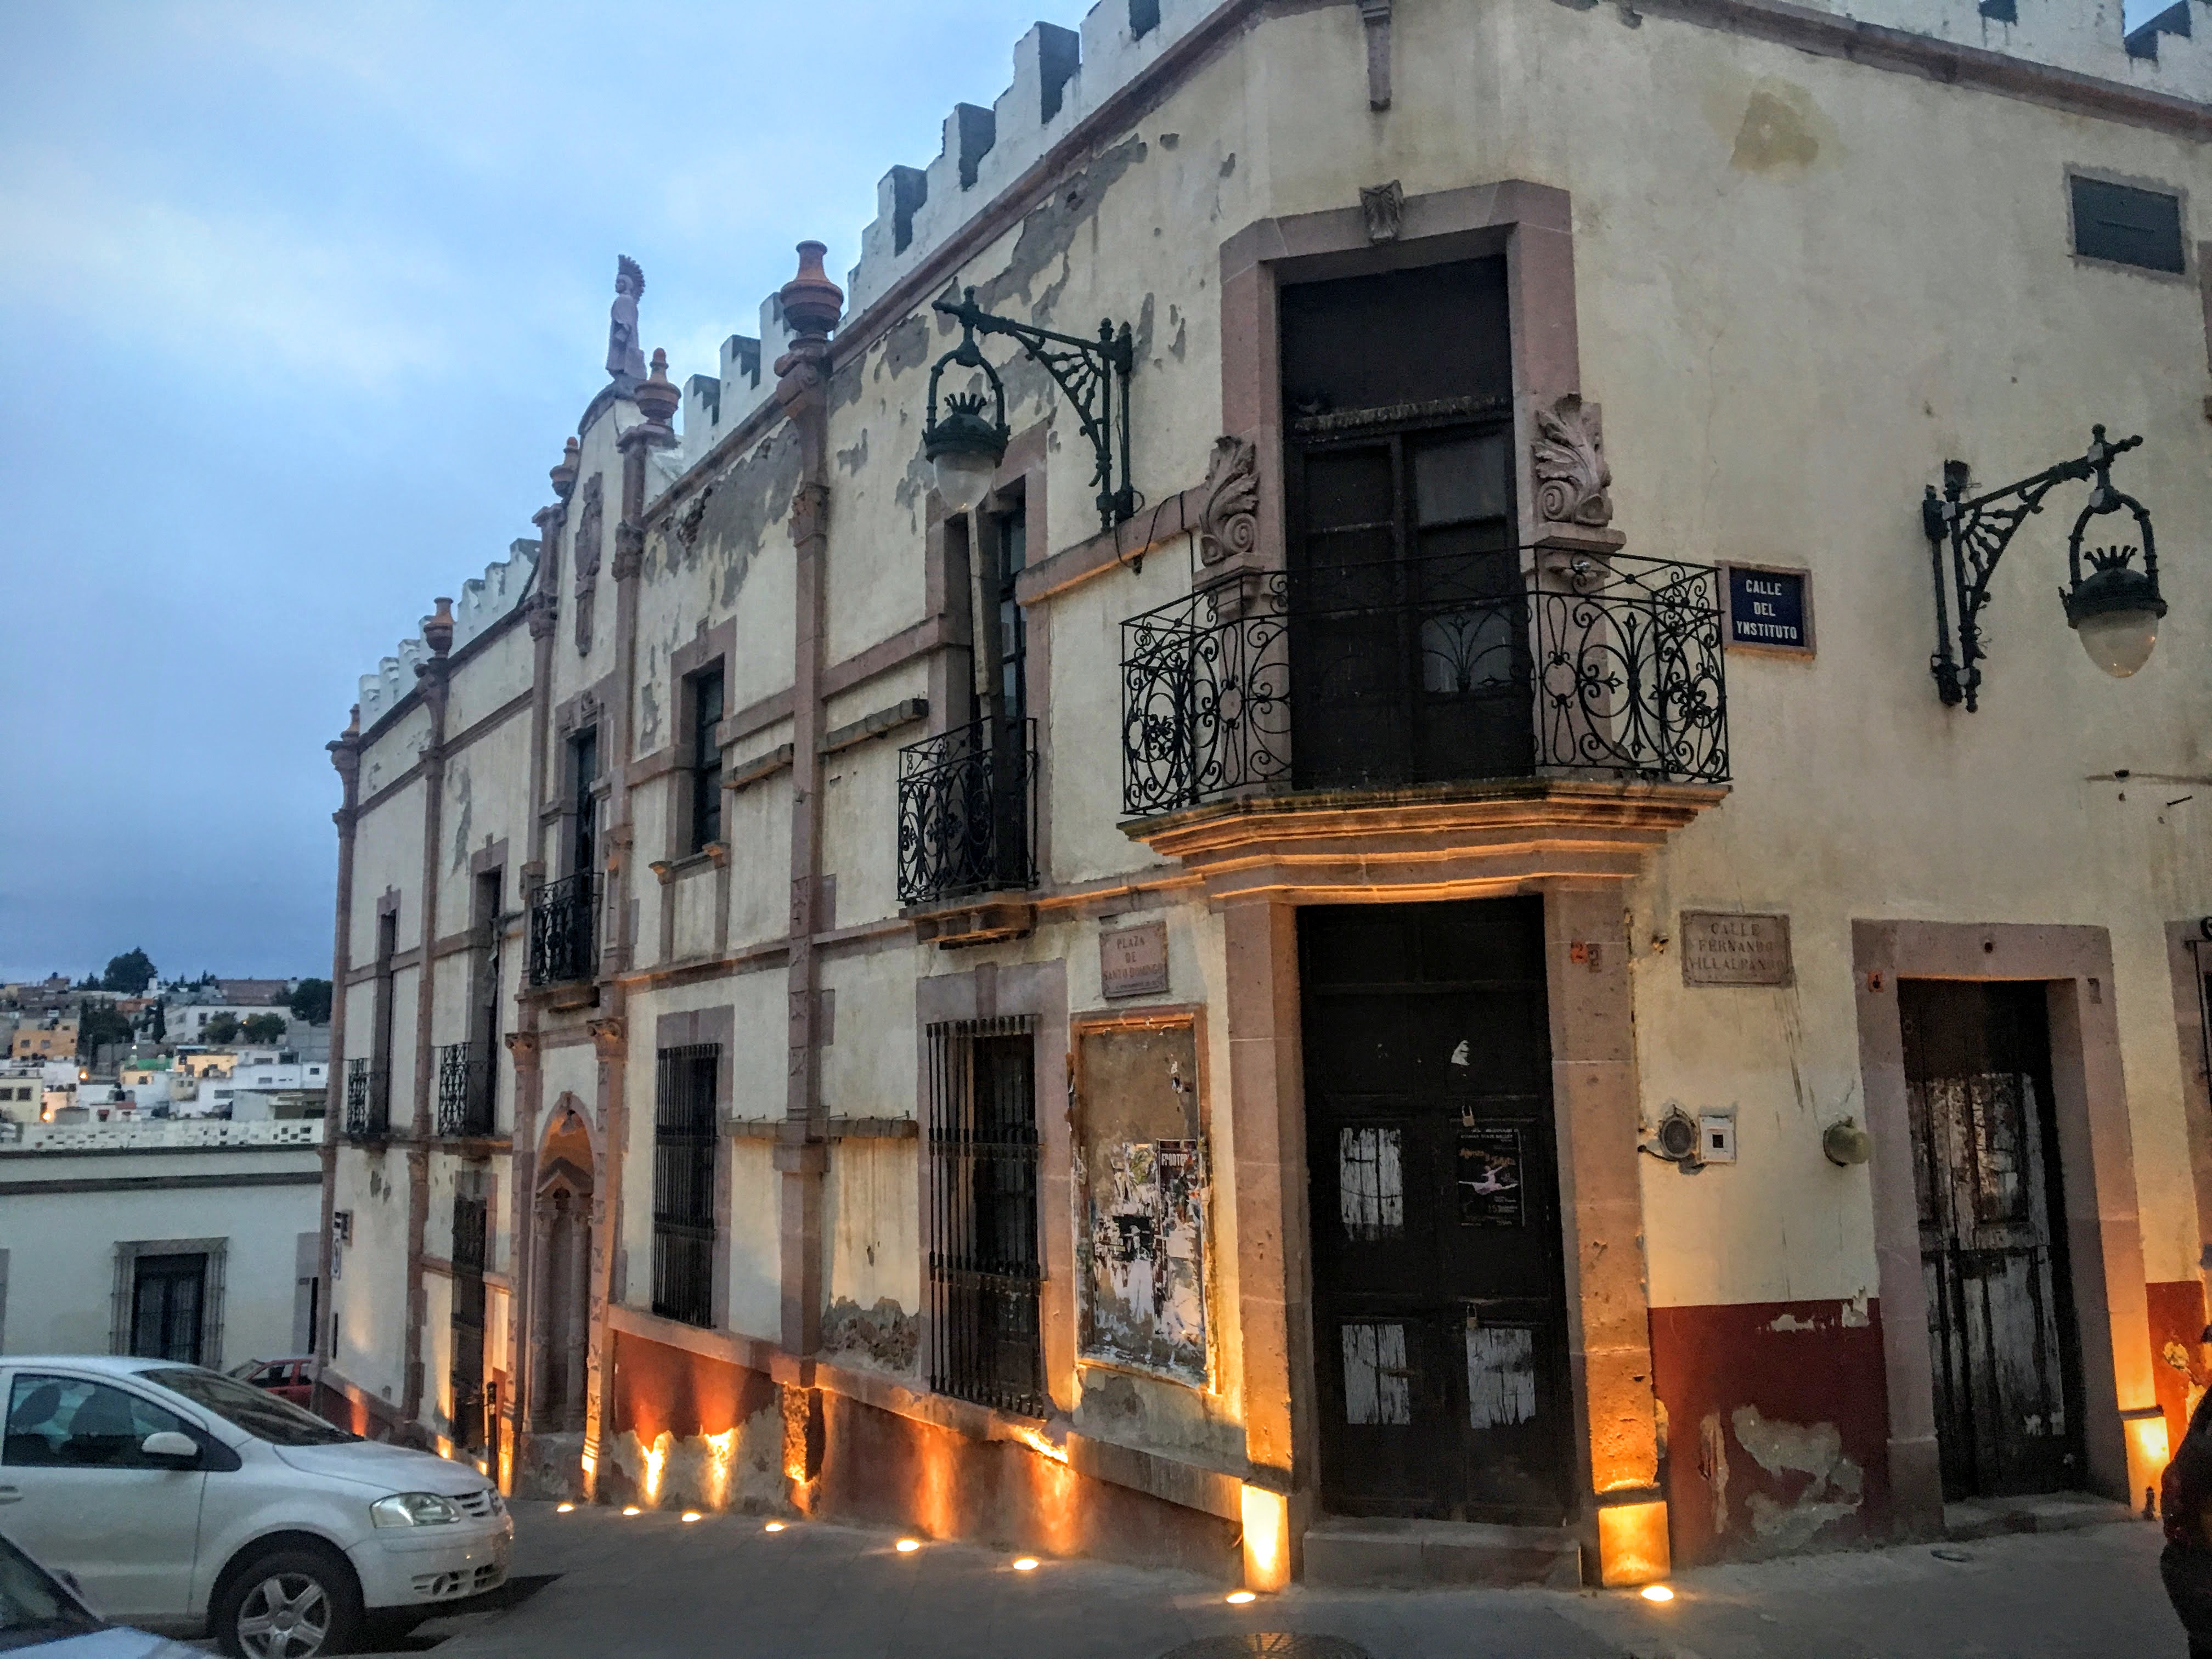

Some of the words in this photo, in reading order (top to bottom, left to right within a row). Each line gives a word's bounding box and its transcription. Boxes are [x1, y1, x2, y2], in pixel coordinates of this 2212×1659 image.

[1746, 579, 1782, 596] CALLE
[1753, 601, 1776, 617] DEL
[1736, 620, 1797, 640] YNSTITUTO
[1711, 923, 1760, 936] CALLE
[1117, 936, 1145, 950] PLAZA
[1699, 939, 1774, 953] FERNANDO
[1125, 951, 1137, 963] DE
[1103, 968, 1128, 980] SANTO
[1129, 963, 1164, 978] DOMINGO
